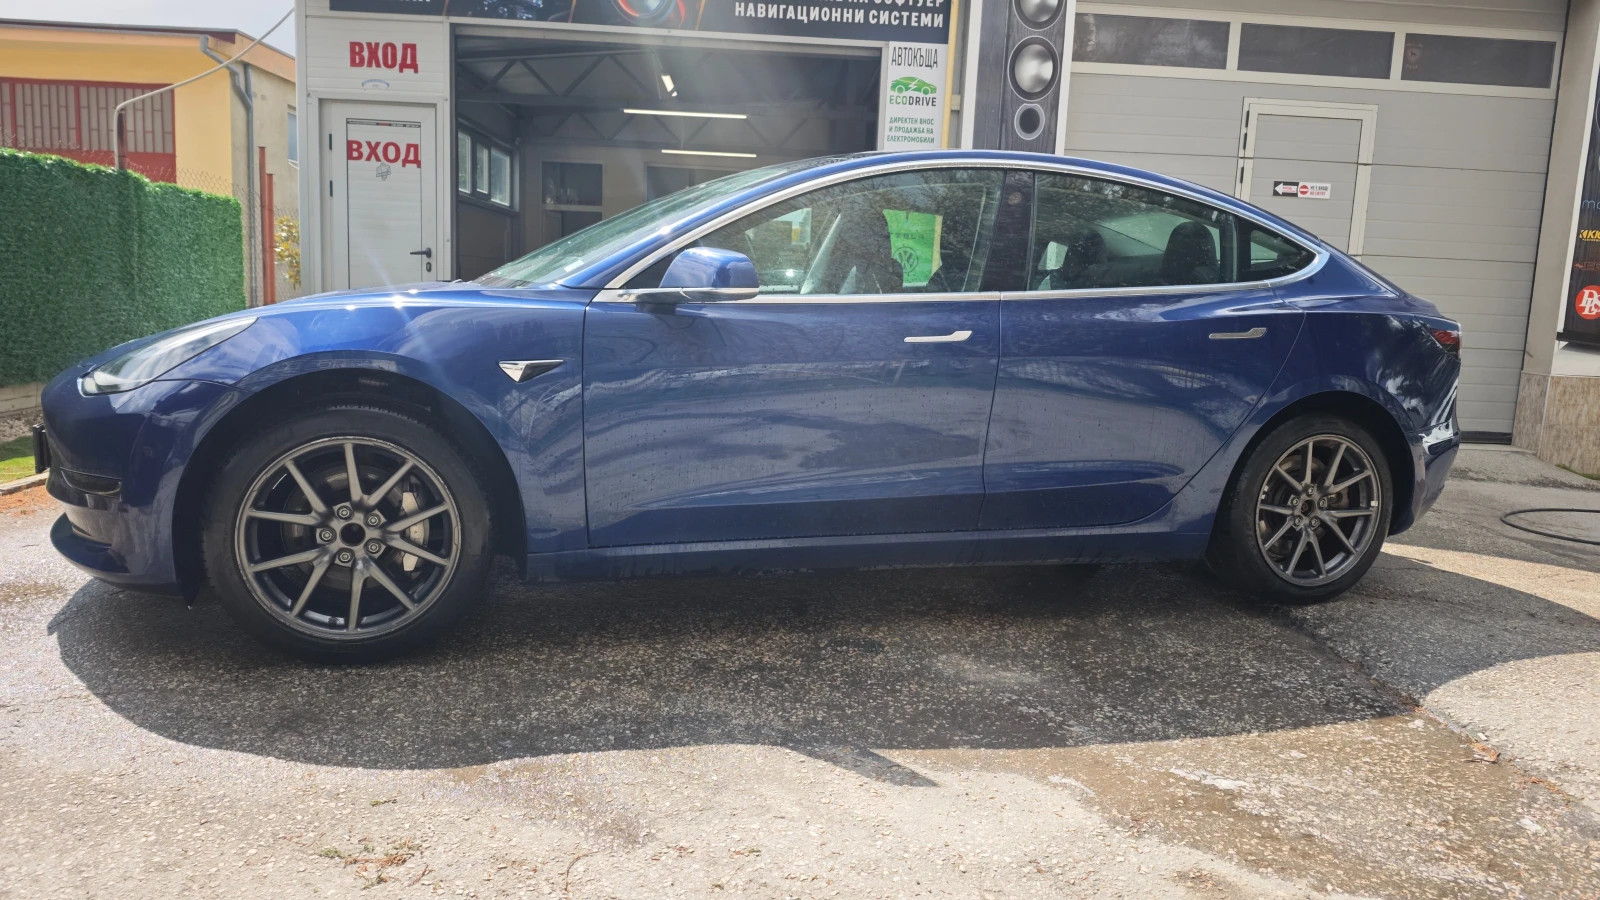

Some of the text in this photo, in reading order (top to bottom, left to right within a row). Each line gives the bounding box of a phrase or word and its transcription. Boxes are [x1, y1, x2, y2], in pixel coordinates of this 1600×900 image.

[735, 5, 943, 27] НАВИГАЦИОННИ СИСТЕМИ
[349, 41, 418, 73] ВХОД
[891, 46, 938, 69] АВТОКЪЩА
[889, 95, 937, 106] ECODRIVE
[887, 135, 935, 143] ЕЛЕКТРОМОБИЛИ
[894, 126, 925, 134] ПРОДАЖБА
[347, 139, 421, 168] ВХОД
